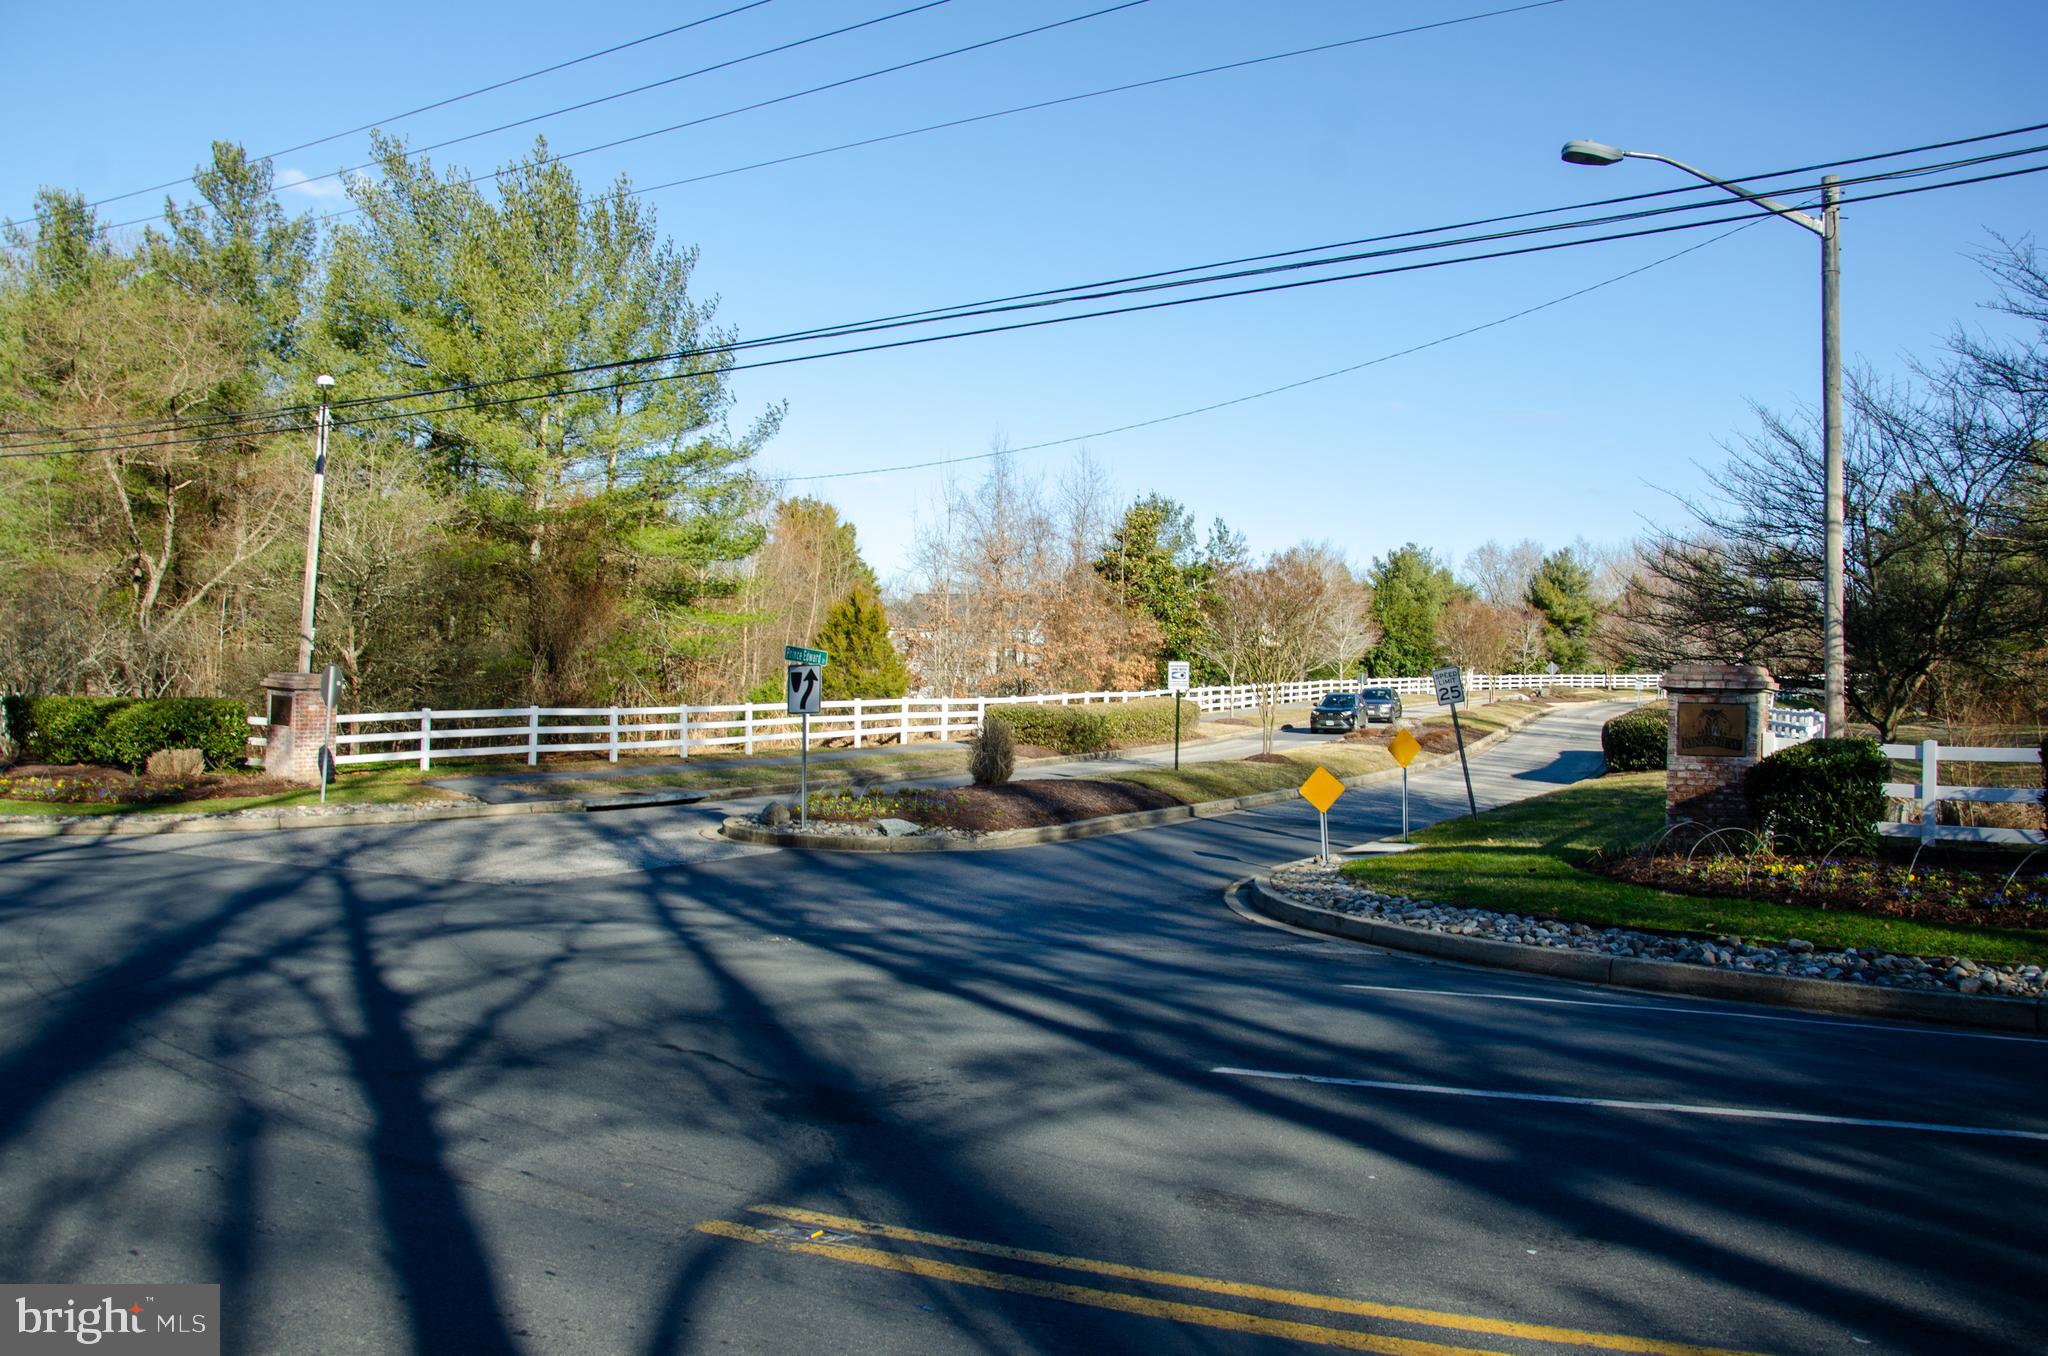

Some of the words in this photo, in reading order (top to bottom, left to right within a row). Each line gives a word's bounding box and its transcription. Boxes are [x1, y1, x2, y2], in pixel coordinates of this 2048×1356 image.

[803, 650, 821, 664] Edward
[1435, 671, 1457, 680] SPEED
[1438, 678, 1456, 686] LIMIT
[1439, 685, 1461, 701] 25
